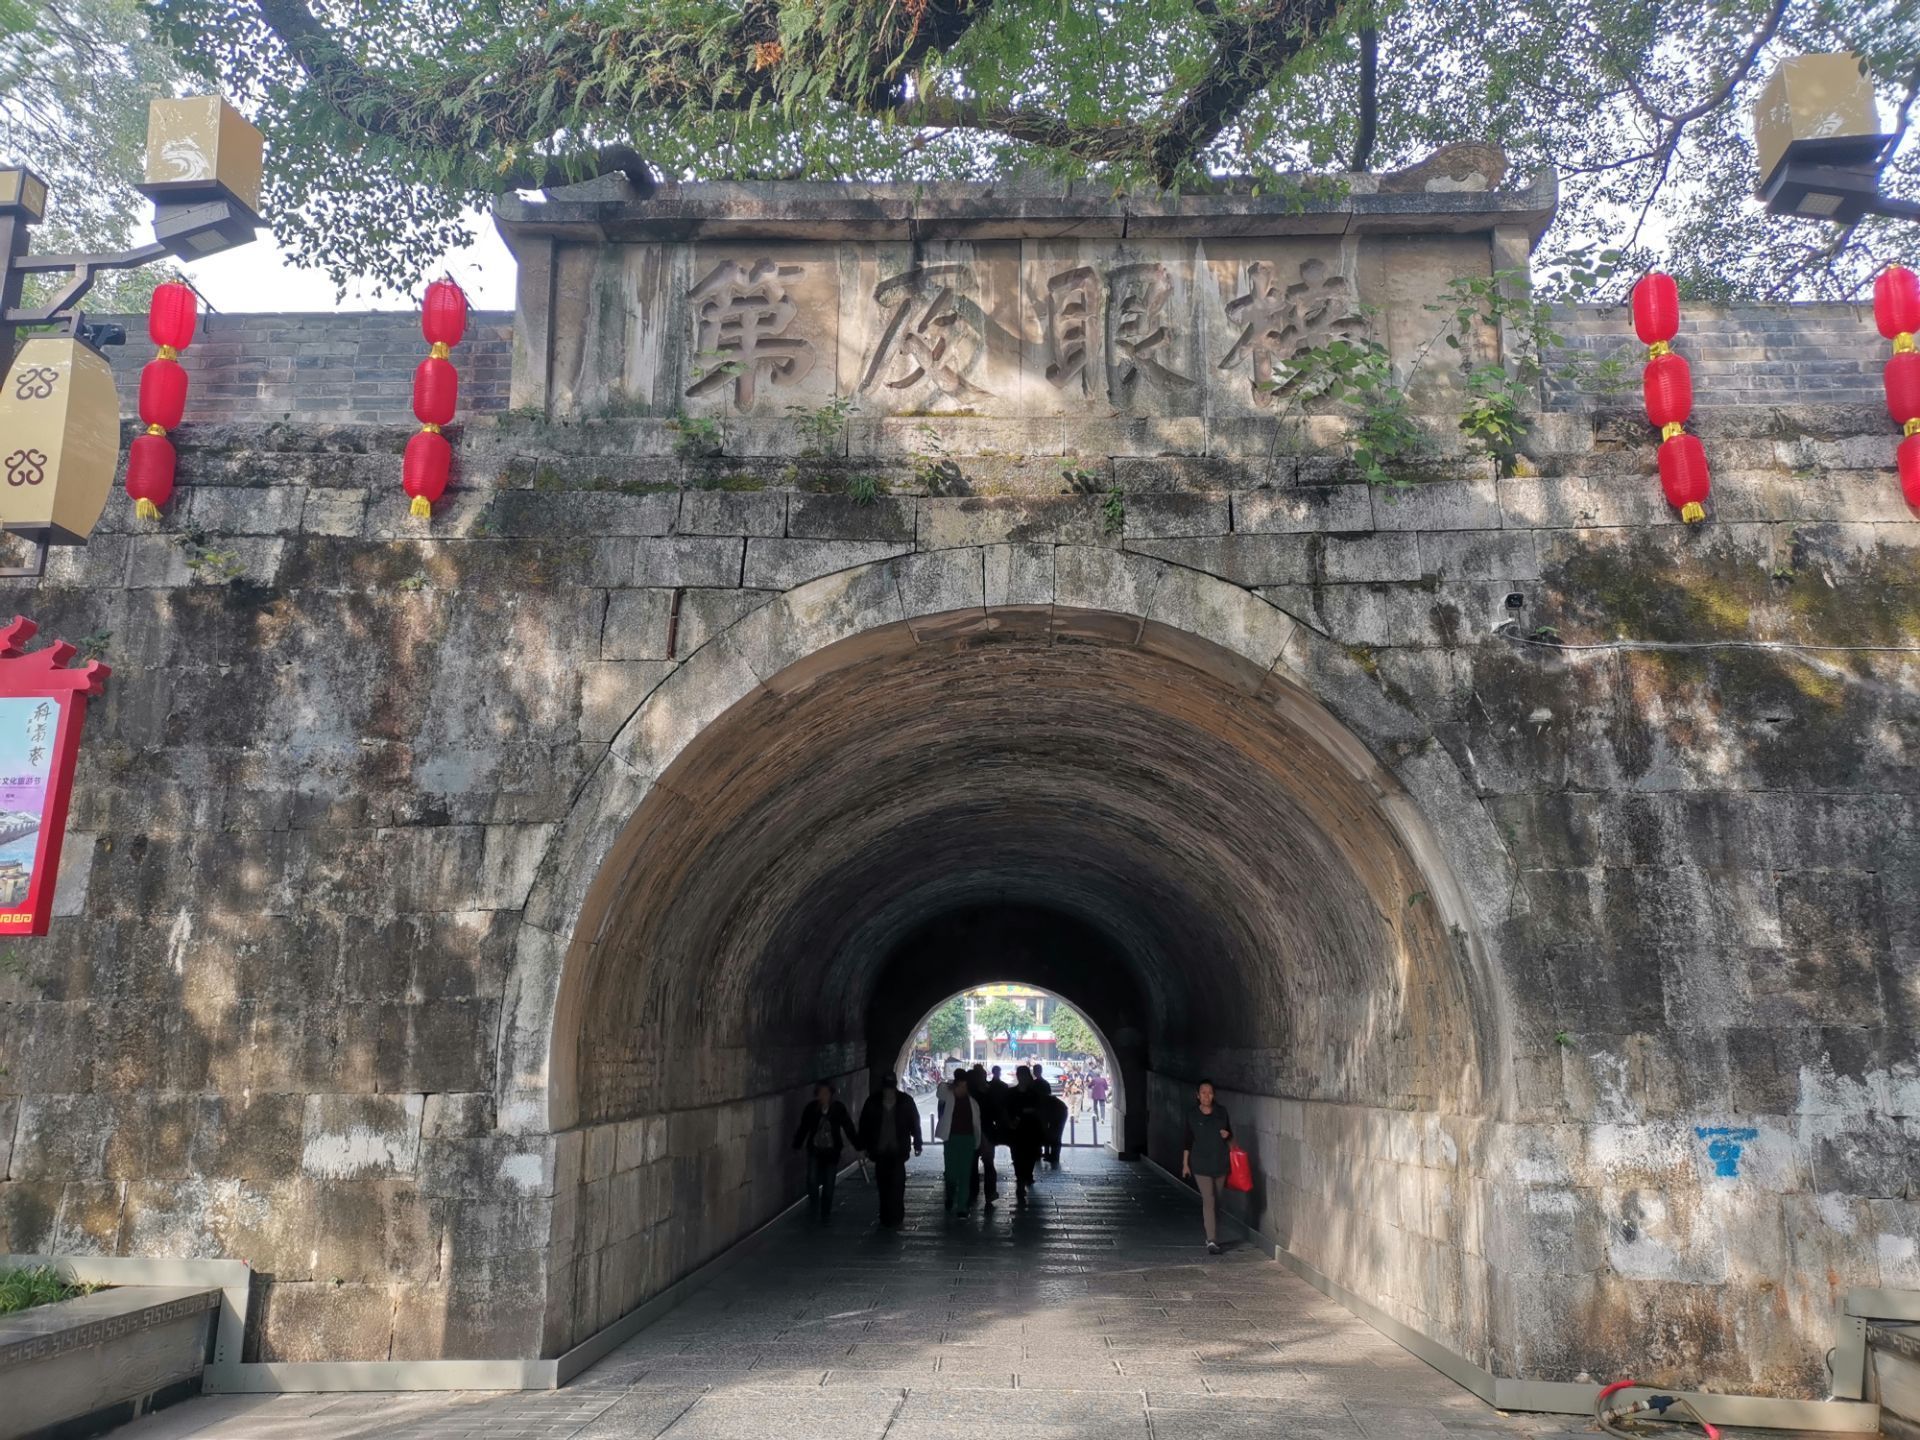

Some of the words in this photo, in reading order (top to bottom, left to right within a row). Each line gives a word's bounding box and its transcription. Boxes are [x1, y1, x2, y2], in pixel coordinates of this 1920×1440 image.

[0, 776, 41, 786] 文化旅游节
